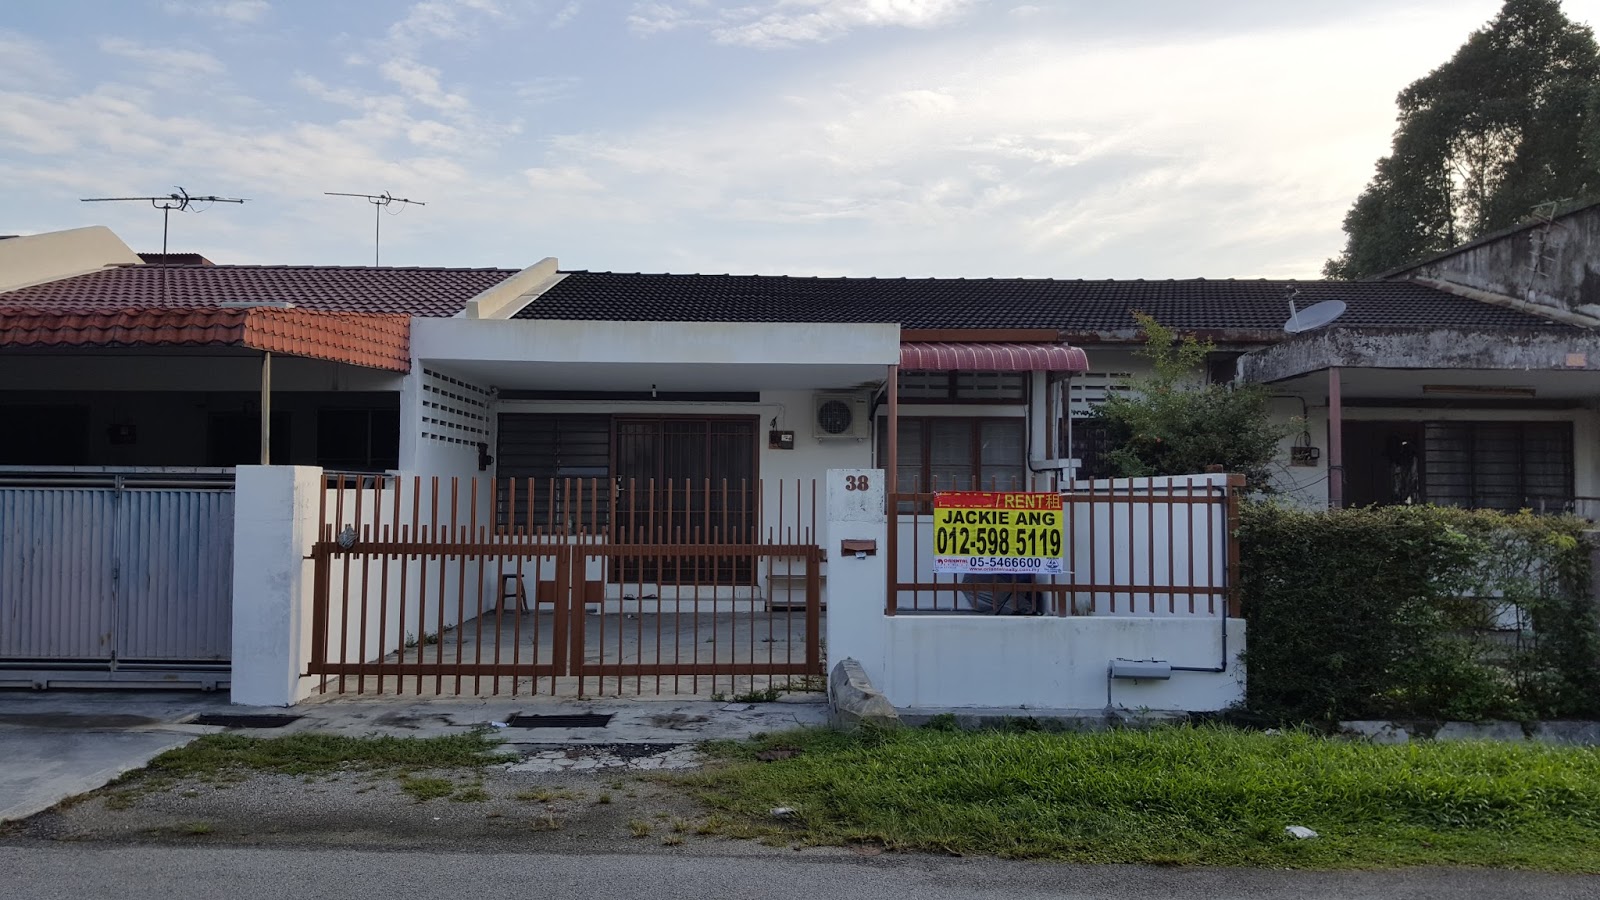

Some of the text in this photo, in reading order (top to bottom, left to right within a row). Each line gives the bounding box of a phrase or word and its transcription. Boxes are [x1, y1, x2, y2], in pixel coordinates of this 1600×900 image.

[845, 475, 869, 491] 38
[1004, 494, 1044, 508] RENT
[942, 511, 1055, 526] JACKIE ANG
[937, 527, 1061, 556] 012-598 5119
[970, 557, 1041, 568] 05-5466600
